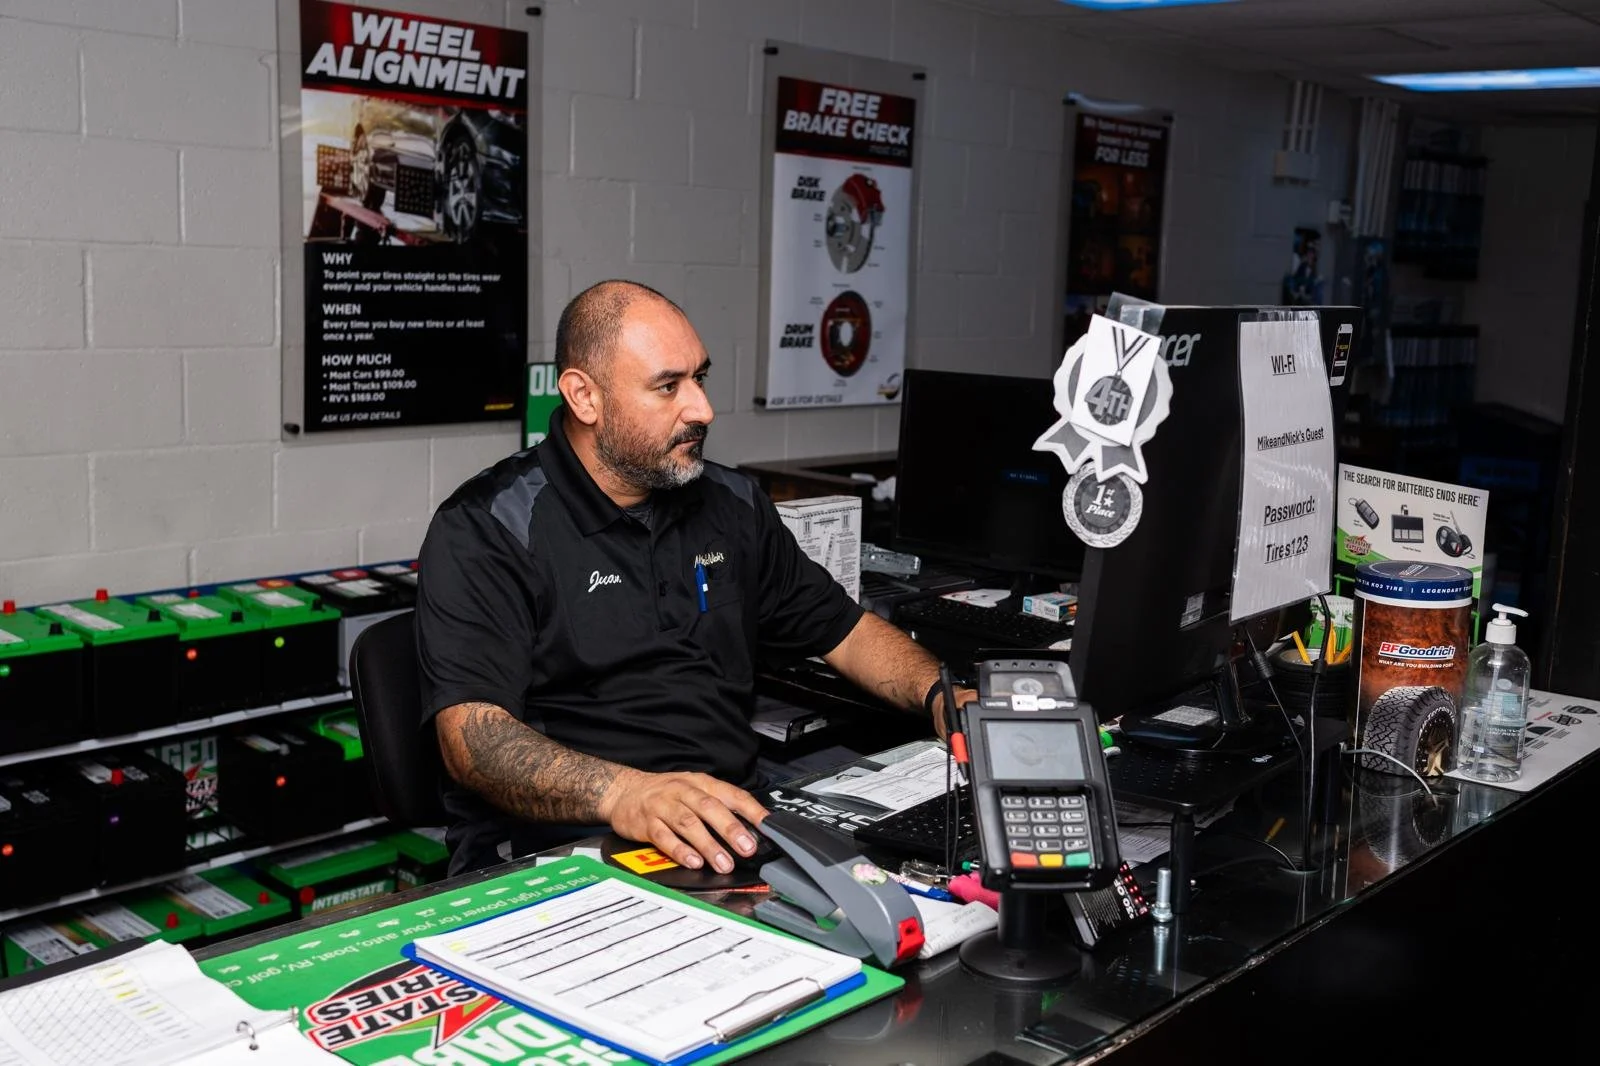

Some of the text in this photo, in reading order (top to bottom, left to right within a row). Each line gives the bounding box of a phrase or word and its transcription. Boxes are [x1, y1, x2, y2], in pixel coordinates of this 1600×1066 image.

[352, 12, 481, 60] WHEEL
[305, 43, 525, 98] ALIGNMENT
[818, 88, 881, 119] FREE
[783, 110, 911, 145] BRAKE CHECK
[1095, 146, 1149, 168] FOR LESS
[797, 176, 821, 188] DISK
[791, 188, 826, 201] BRAKE
[322, 252, 352, 265] WHY
[323, 269, 501, 282] To point your tires straight so the tires wear
[323, 282, 482, 294] evenly and your vehicle handles safely.
[322, 303, 361, 315] WHEN
[323, 319, 348, 330] Every
[350, 319, 370, 329] time
[371, 321, 388, 330] you
[389, 319, 405, 330] buy
[426, 319, 444, 328] tires
[445, 320, 455, 328] or
[456, 319, 465, 328] at
[466, 318, 485, 328] least
[784, 324, 814, 335] DRUM
[323, 332, 375, 342] once a year.
[779, 336, 815, 349] BRAKE
[1158, 333, 1201, 367] cer
[321, 353, 391, 366] HOW MUCH
[1271, 354, 1296, 374] WI-FI
[329, 368, 405, 380] Most Cars $99.00
[329, 382, 351, 391] Most
[352, 381, 380, 391] Trucks
[1085, 377, 1134, 421] 4TH
[321, 410, 401, 423] ASK US FOR DETAILS
[1305, 426, 1324, 444] Guest
[1092, 485, 1115, 506] 1st
[1344, 470, 1480, 507] THE SEARCH FOR BATTERIES ENDS HERE
[1085, 504, 1115, 518] Place
[1263, 496, 1315, 526] Password:
[1265, 535, 1309, 564] Tires123
[1380, 643, 1455, 656] BFGoodrich
[542, 881, 567, 892] the
[568, 875, 599, 887] Find
[312, 880, 387, 911] INTERSTATE
[506, 890, 541, 904] right
[462, 900, 508, 917] power
[438, 912, 462, 925] for
[403, 920, 436, 936] your
[356, 932, 399, 948] auto,
[312, 945, 360, 961] boat,
[283, 959, 315, 971] RV,
[247, 968, 282, 985] golf
